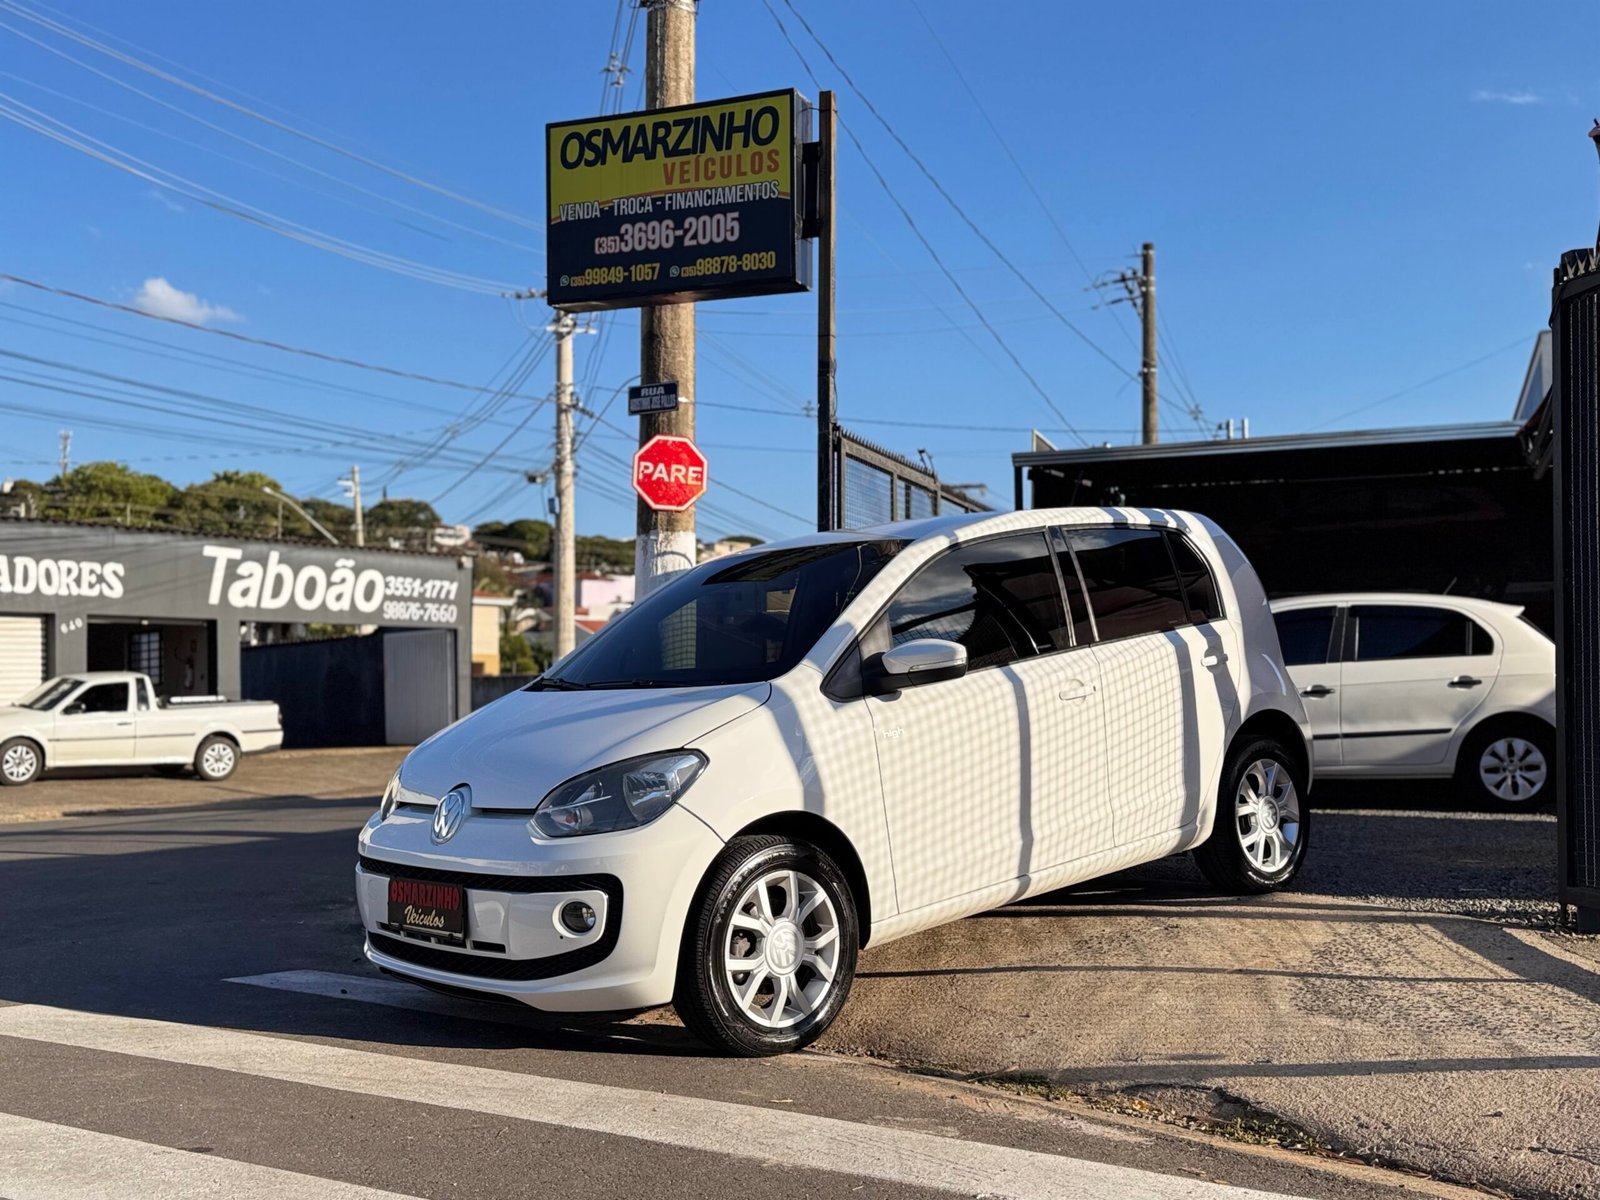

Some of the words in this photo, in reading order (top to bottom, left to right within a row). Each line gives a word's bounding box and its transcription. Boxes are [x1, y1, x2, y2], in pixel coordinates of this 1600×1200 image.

[560, 105, 780, 170] OSMARZINHO
[662, 149, 780, 186] VEÍCULOS
[559, 202, 600, 222] VENDA
[612, 195, 653, 217] TROCA
[665, 180, 779, 211] FINANCIAMENTOS
[641, 386, 665, 397] RUA
[638, 461, 702, 486] PARE
[202, 544, 386, 614] Taboão
[385, 575, 459, 601] 3551-1771
[382, 600, 458, 624] 98876-7660
[882, 727, 904, 739] high
[391, 880, 460, 911] OSMARZINHO
